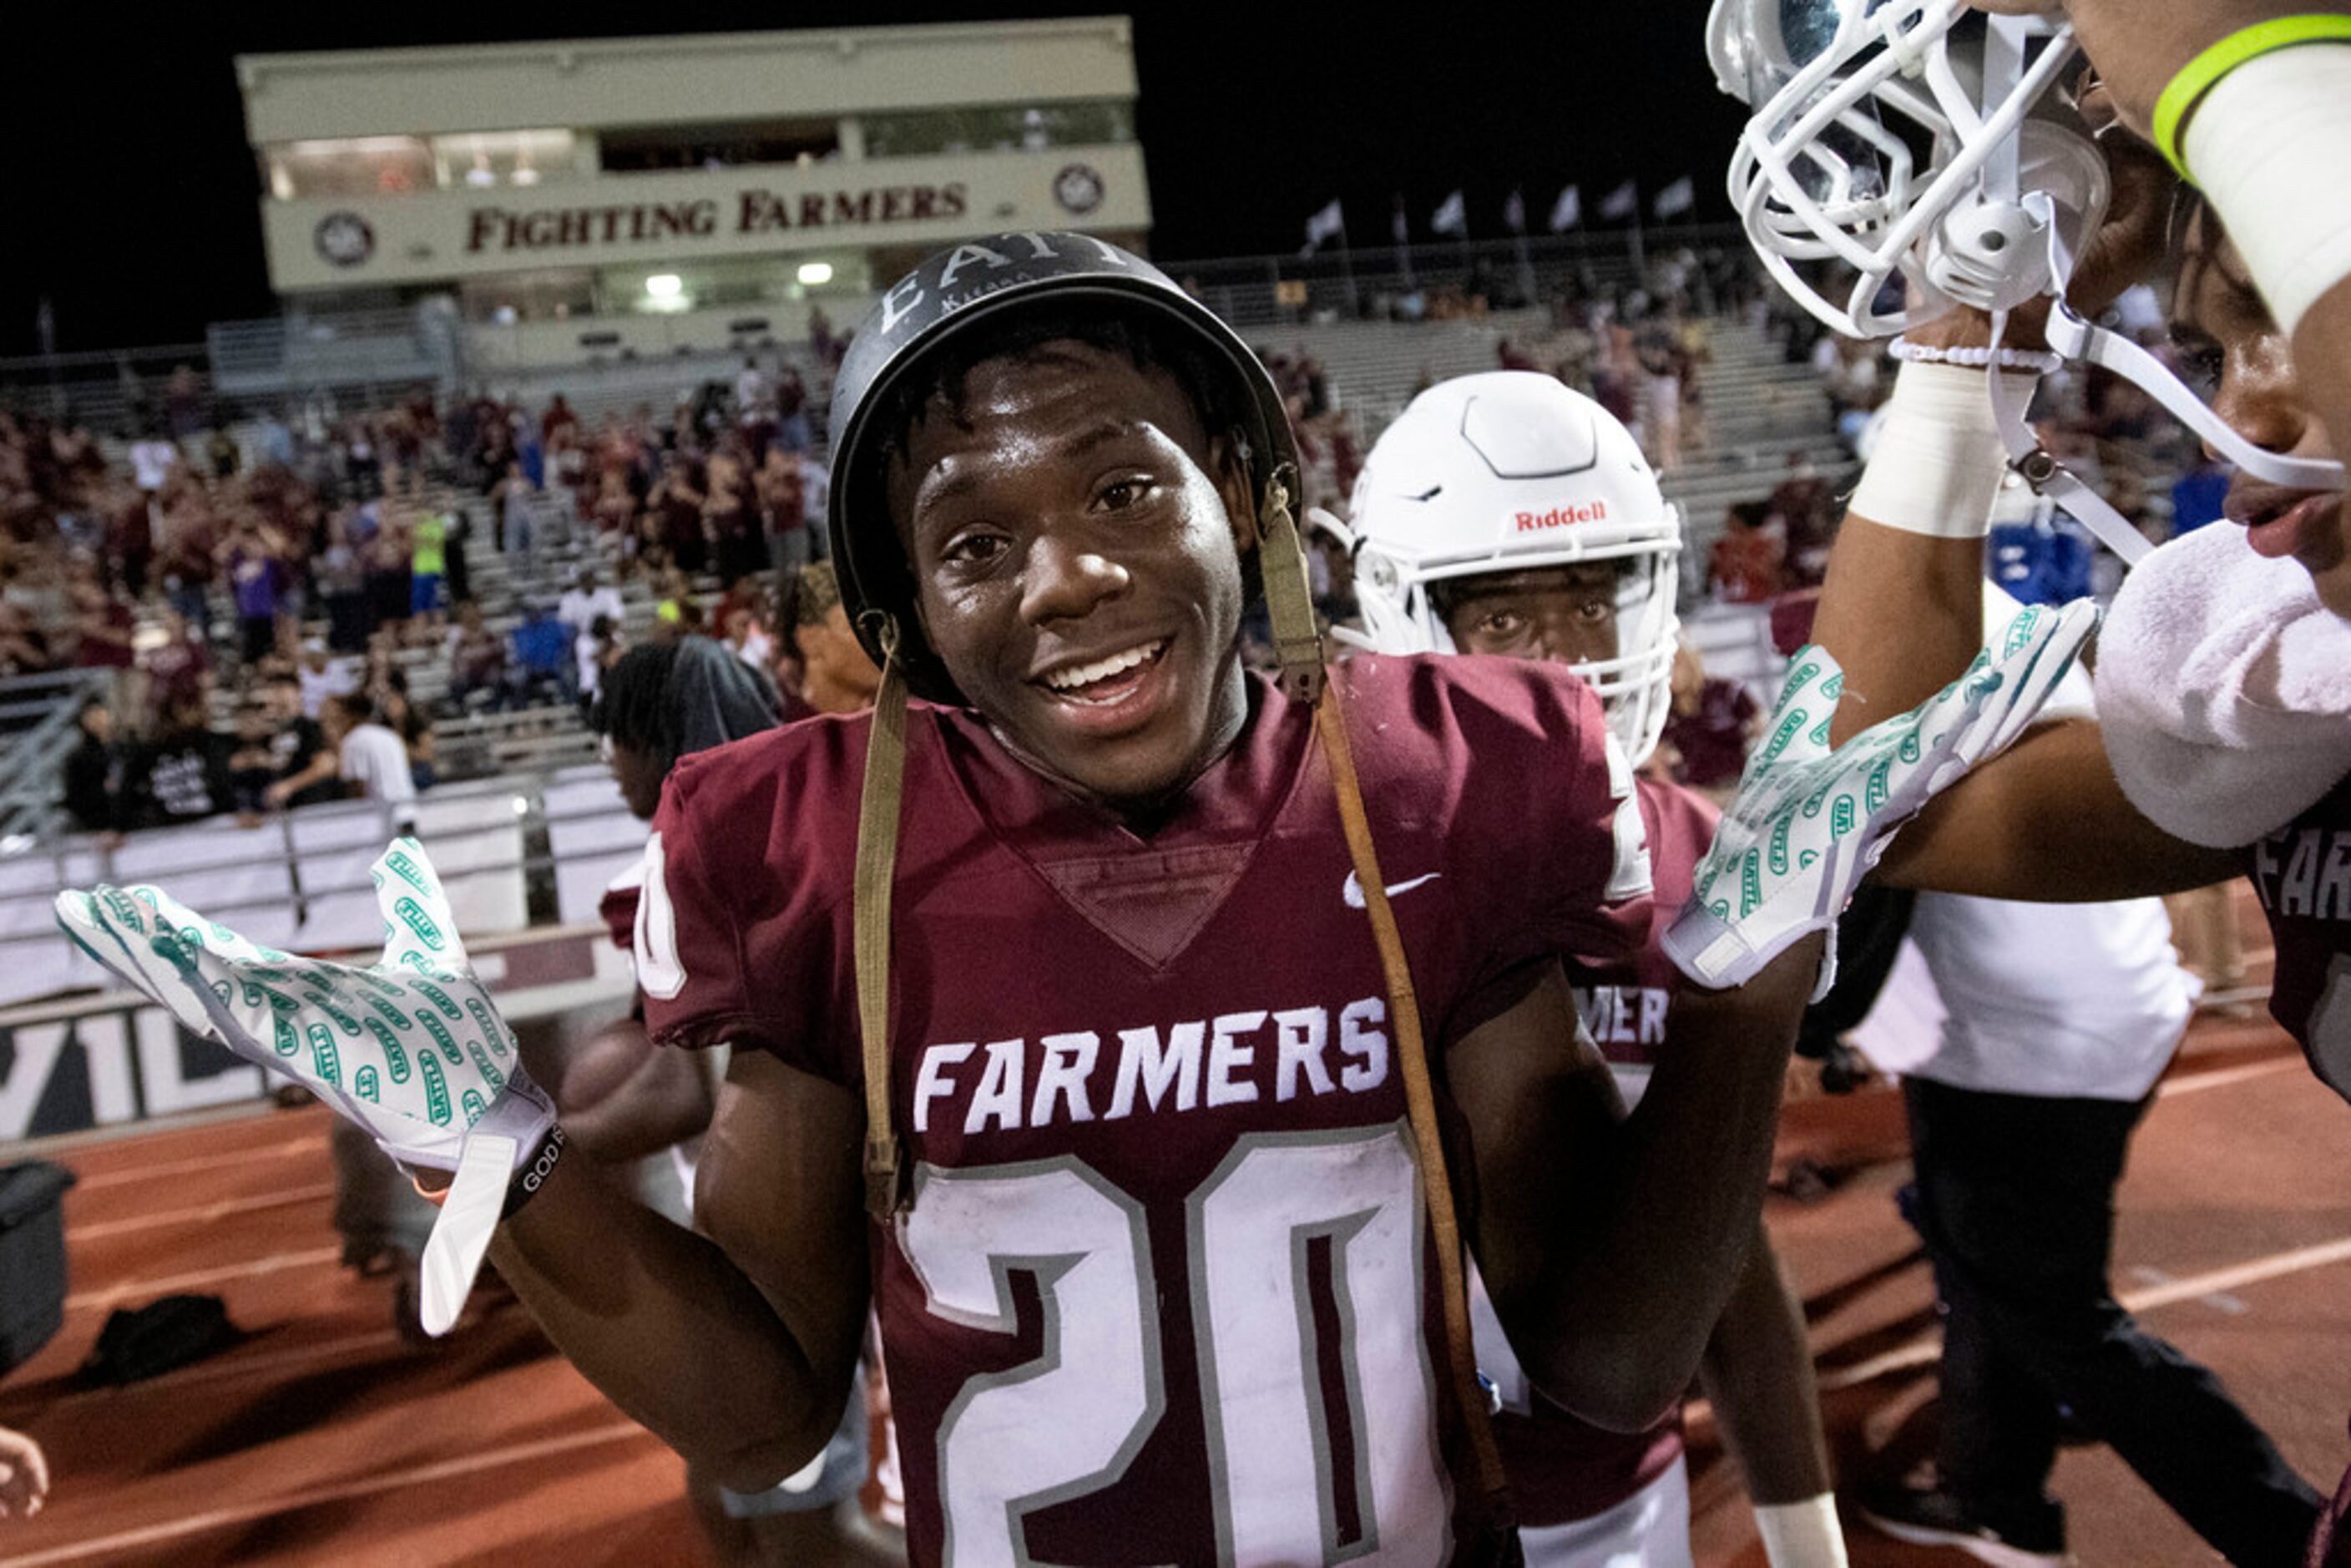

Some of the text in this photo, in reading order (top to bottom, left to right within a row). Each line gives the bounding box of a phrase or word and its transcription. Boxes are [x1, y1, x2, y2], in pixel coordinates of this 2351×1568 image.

[468, 183, 968, 252] FIGHTING FARMERS
[1515, 501, 1607, 533] Riddell
[913, 996, 1388, 1134] FARMERS
[523, 1143, 559, 1191] GOD
[895, 1115, 1454, 1568] 20
